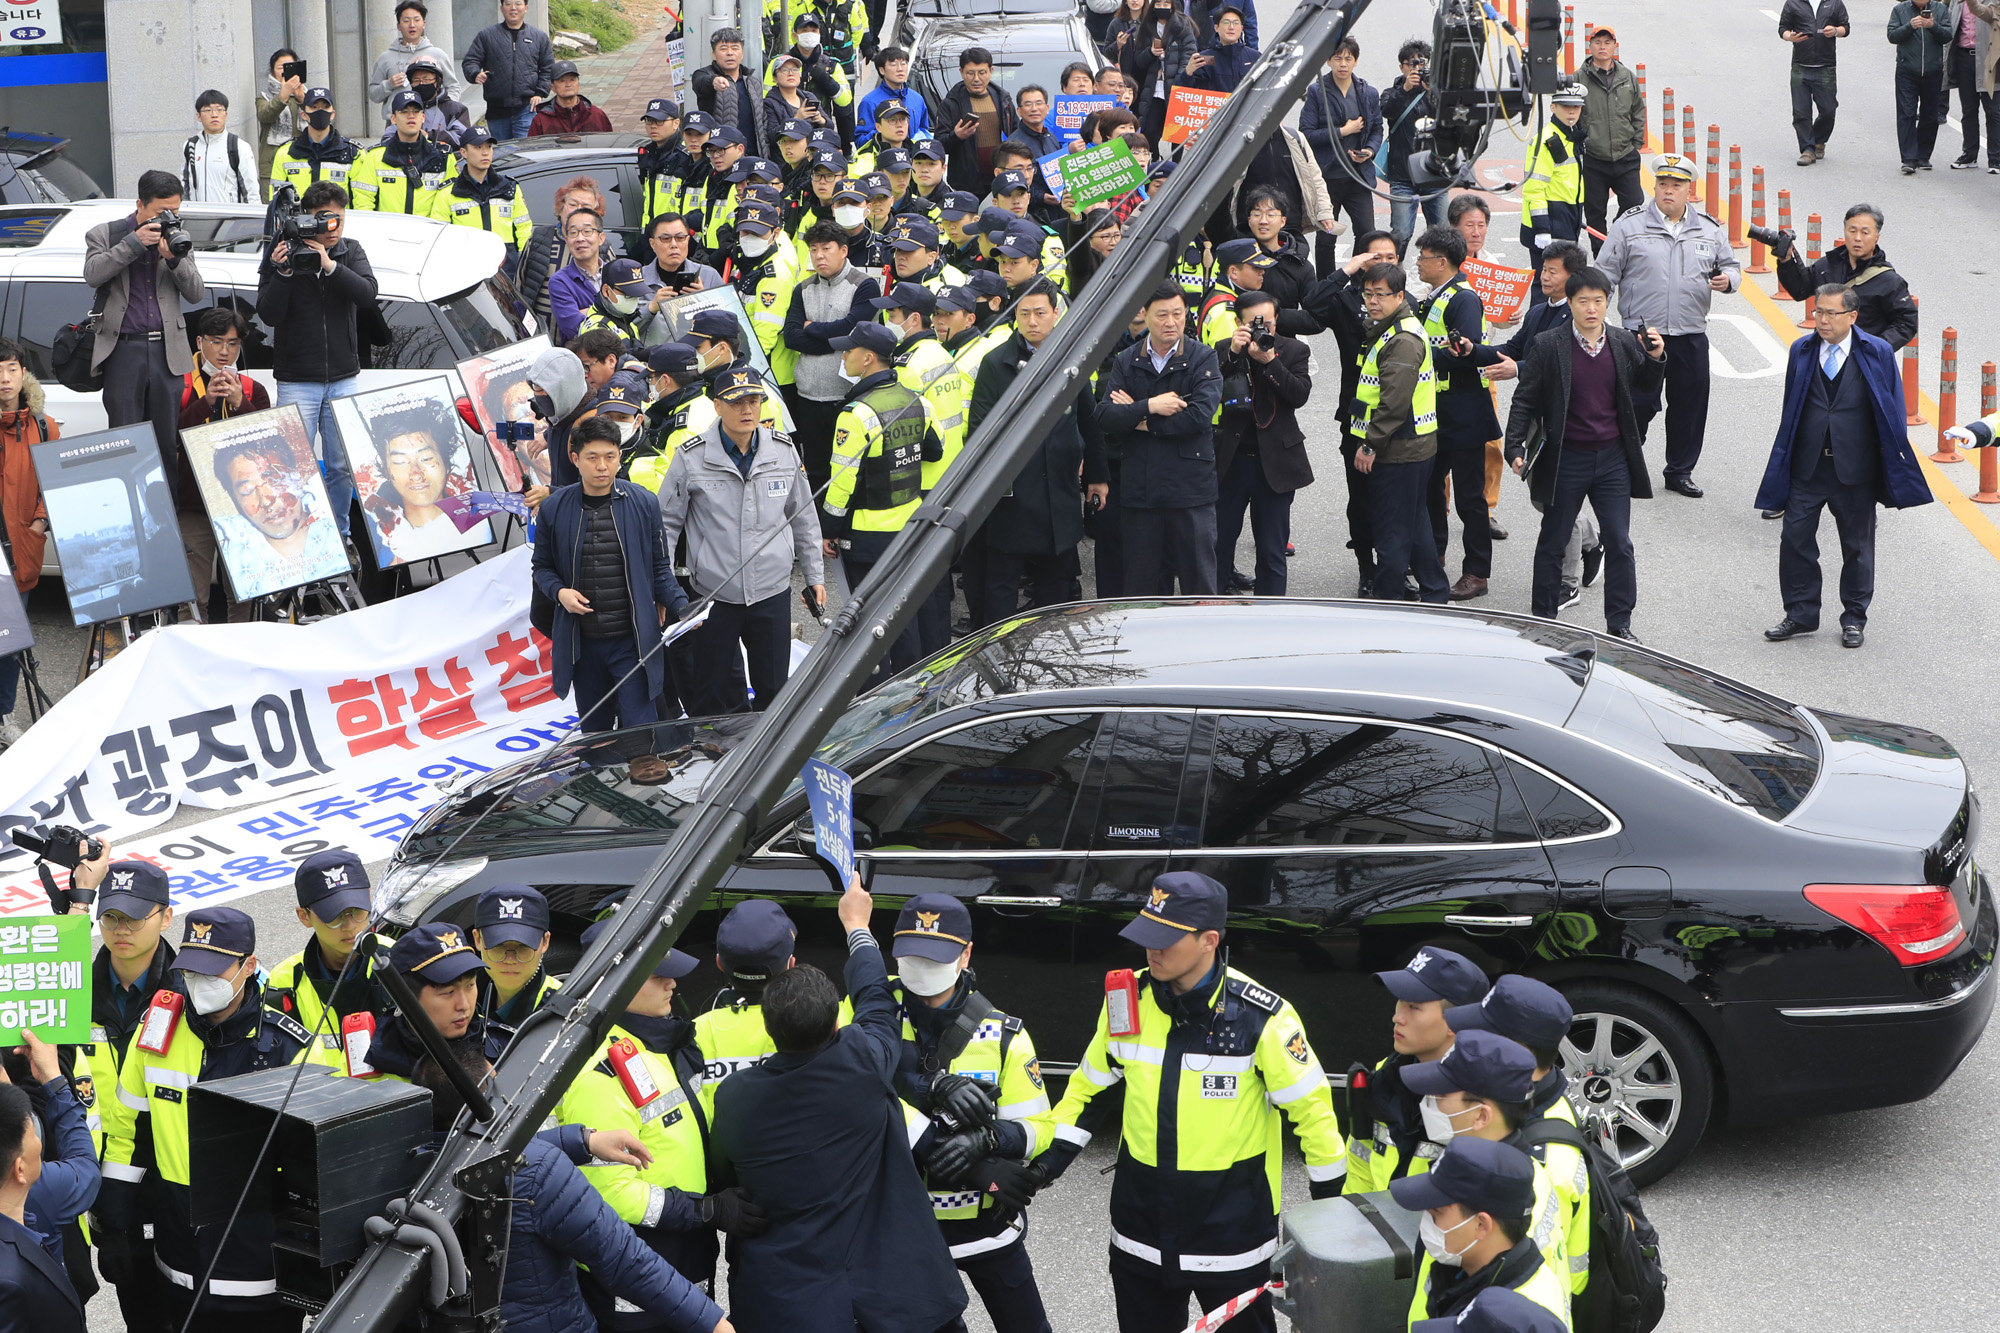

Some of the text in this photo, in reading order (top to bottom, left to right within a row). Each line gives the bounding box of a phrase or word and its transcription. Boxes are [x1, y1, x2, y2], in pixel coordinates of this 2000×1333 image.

[1175, 91, 1203, 104] 국민의
[1066, 146, 1115, 173] 전두환은
[1089, 156, 1134, 181] 영령앞에
[1078, 172, 1135, 202] 사죄하라!
[1463, 261, 1492, 277] 국민의
[1475, 277, 1515, 294] 전두환은
[1493, 294, 1520, 306] 심판을
[1483, 305, 1503, 317] 으라
[100, 688, 336, 817] 광주의
[327, 656, 488, 758] 학살
[237, 755, 494, 841] 민주주의
[1109, 826, 1160, 837] LIMOUSINE
[0, 998, 68, 1029] 하라!
[1204, 1075, 1235, 1090] 경찰
